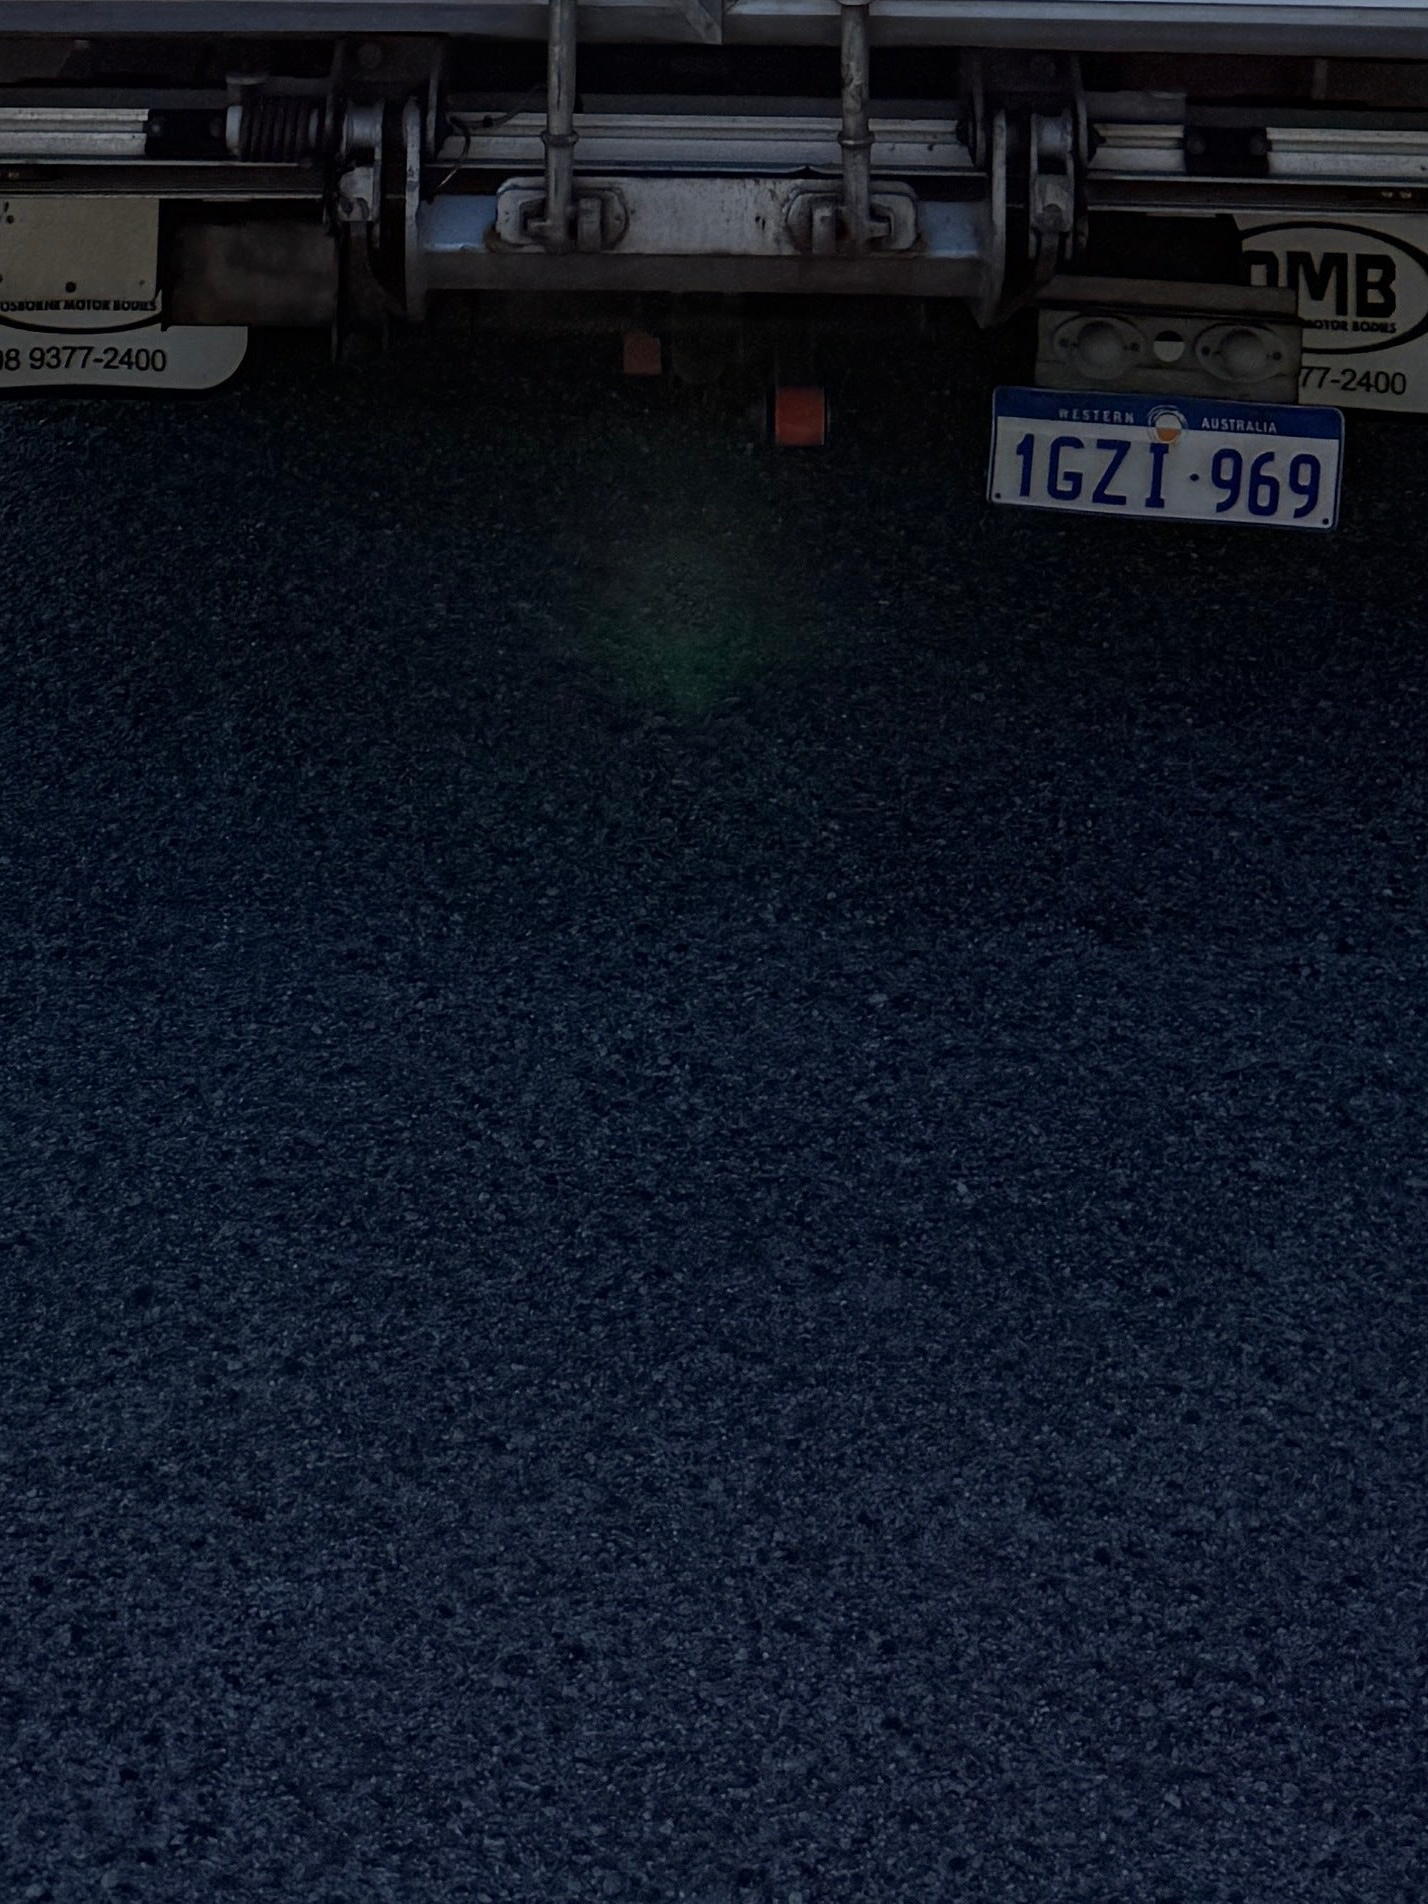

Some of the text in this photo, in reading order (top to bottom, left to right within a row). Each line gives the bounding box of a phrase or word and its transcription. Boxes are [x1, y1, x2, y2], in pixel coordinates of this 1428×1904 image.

[1352, 320, 1397, 334] BODIES
[28, 346, 167, 373] 9377-2400
[1300, 365, 1407, 396] 77-2400
[1058, 408, 1277, 434] WESTERN AUSTRALIA
